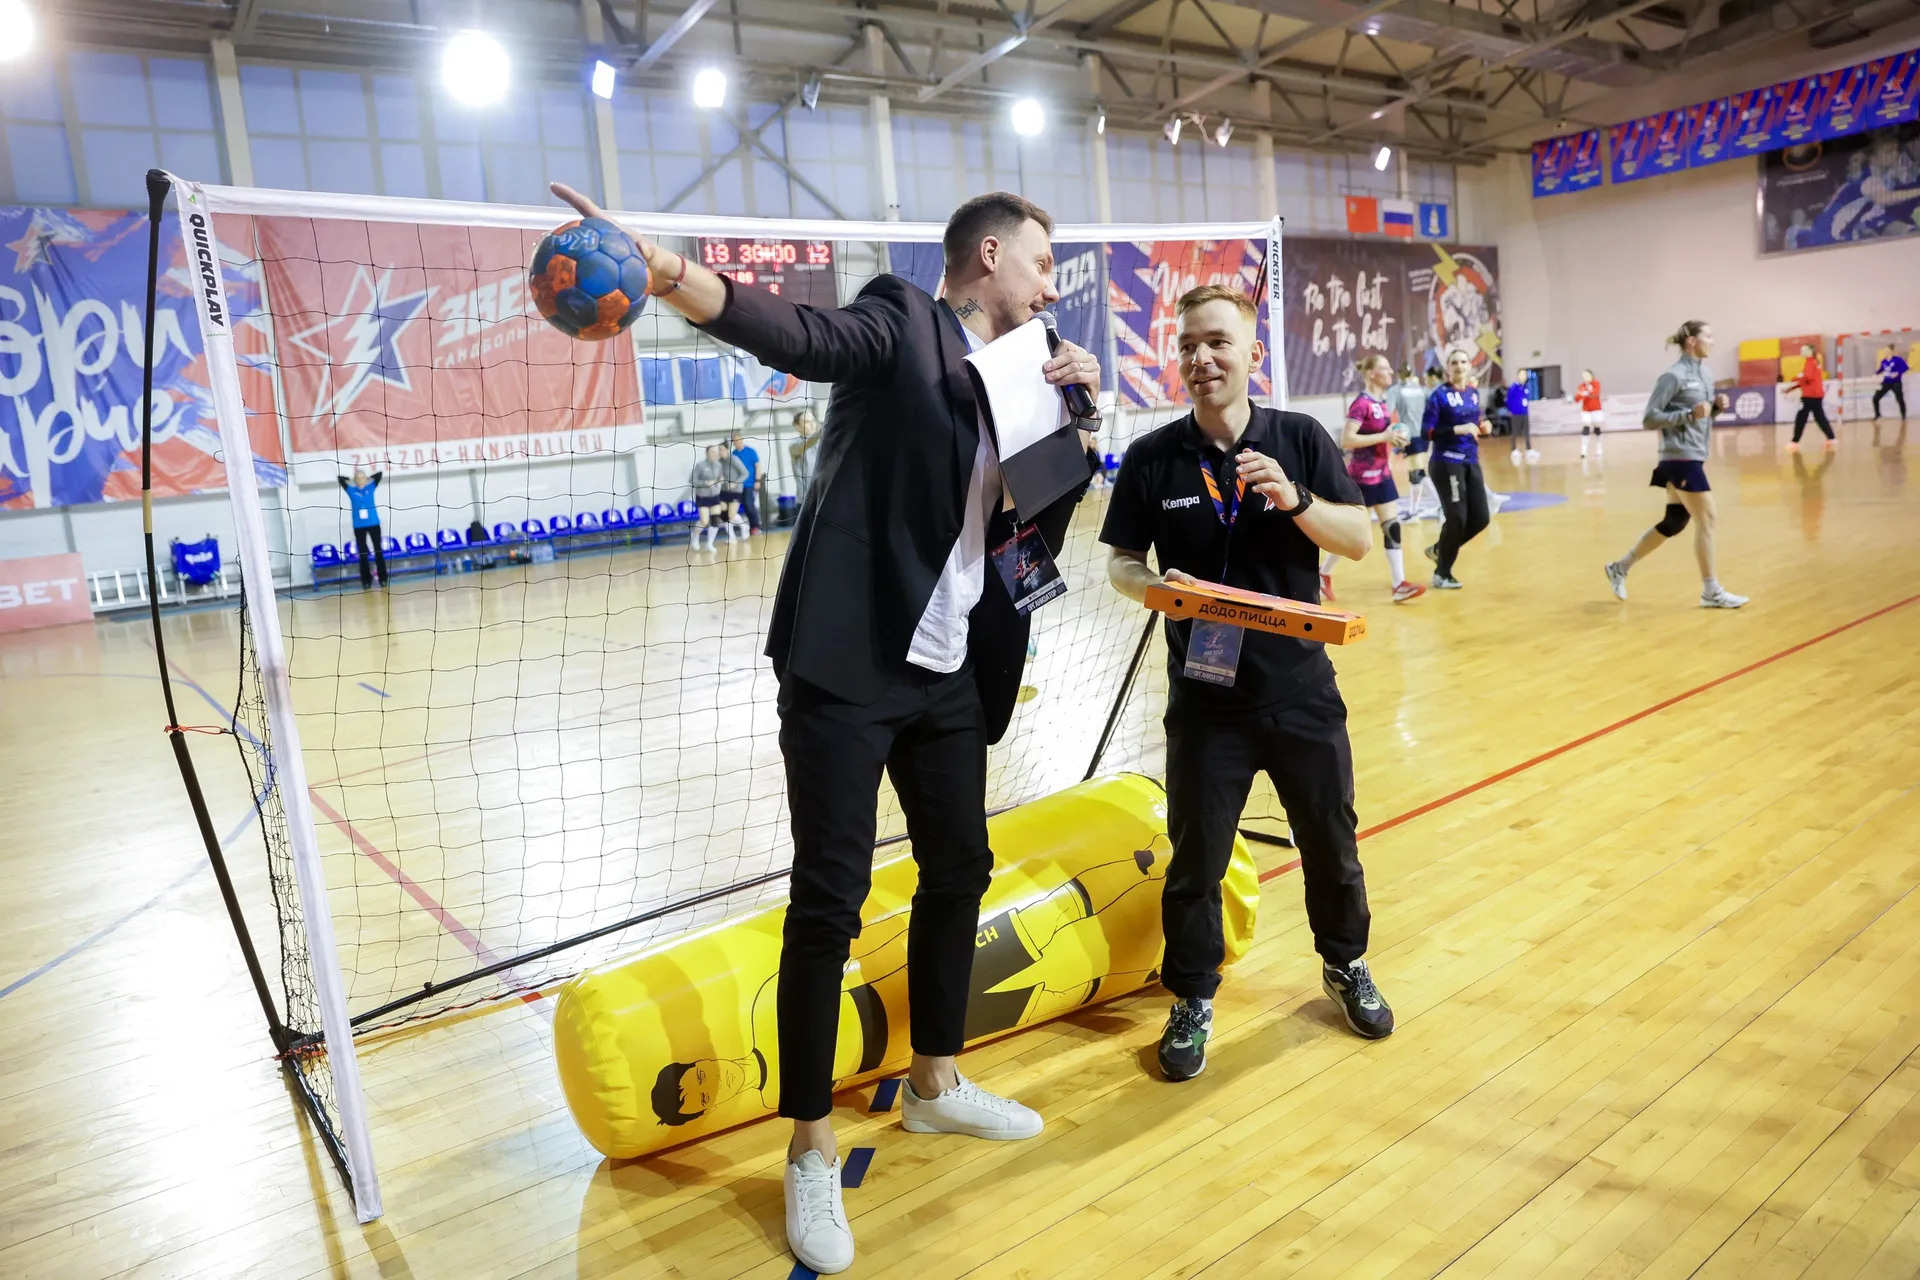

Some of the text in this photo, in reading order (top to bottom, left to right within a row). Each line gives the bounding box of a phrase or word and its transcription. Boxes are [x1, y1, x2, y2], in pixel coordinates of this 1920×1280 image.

[189, 213, 224, 327] QUICKPLAY
[1272, 240, 1280, 300] KICKSTER
[437, 271, 538, 348] ЗВЕ
[1162, 495, 1200, 511] Kempa
[1199, 603, 1287, 628] ДОДО ПИЦЦА
